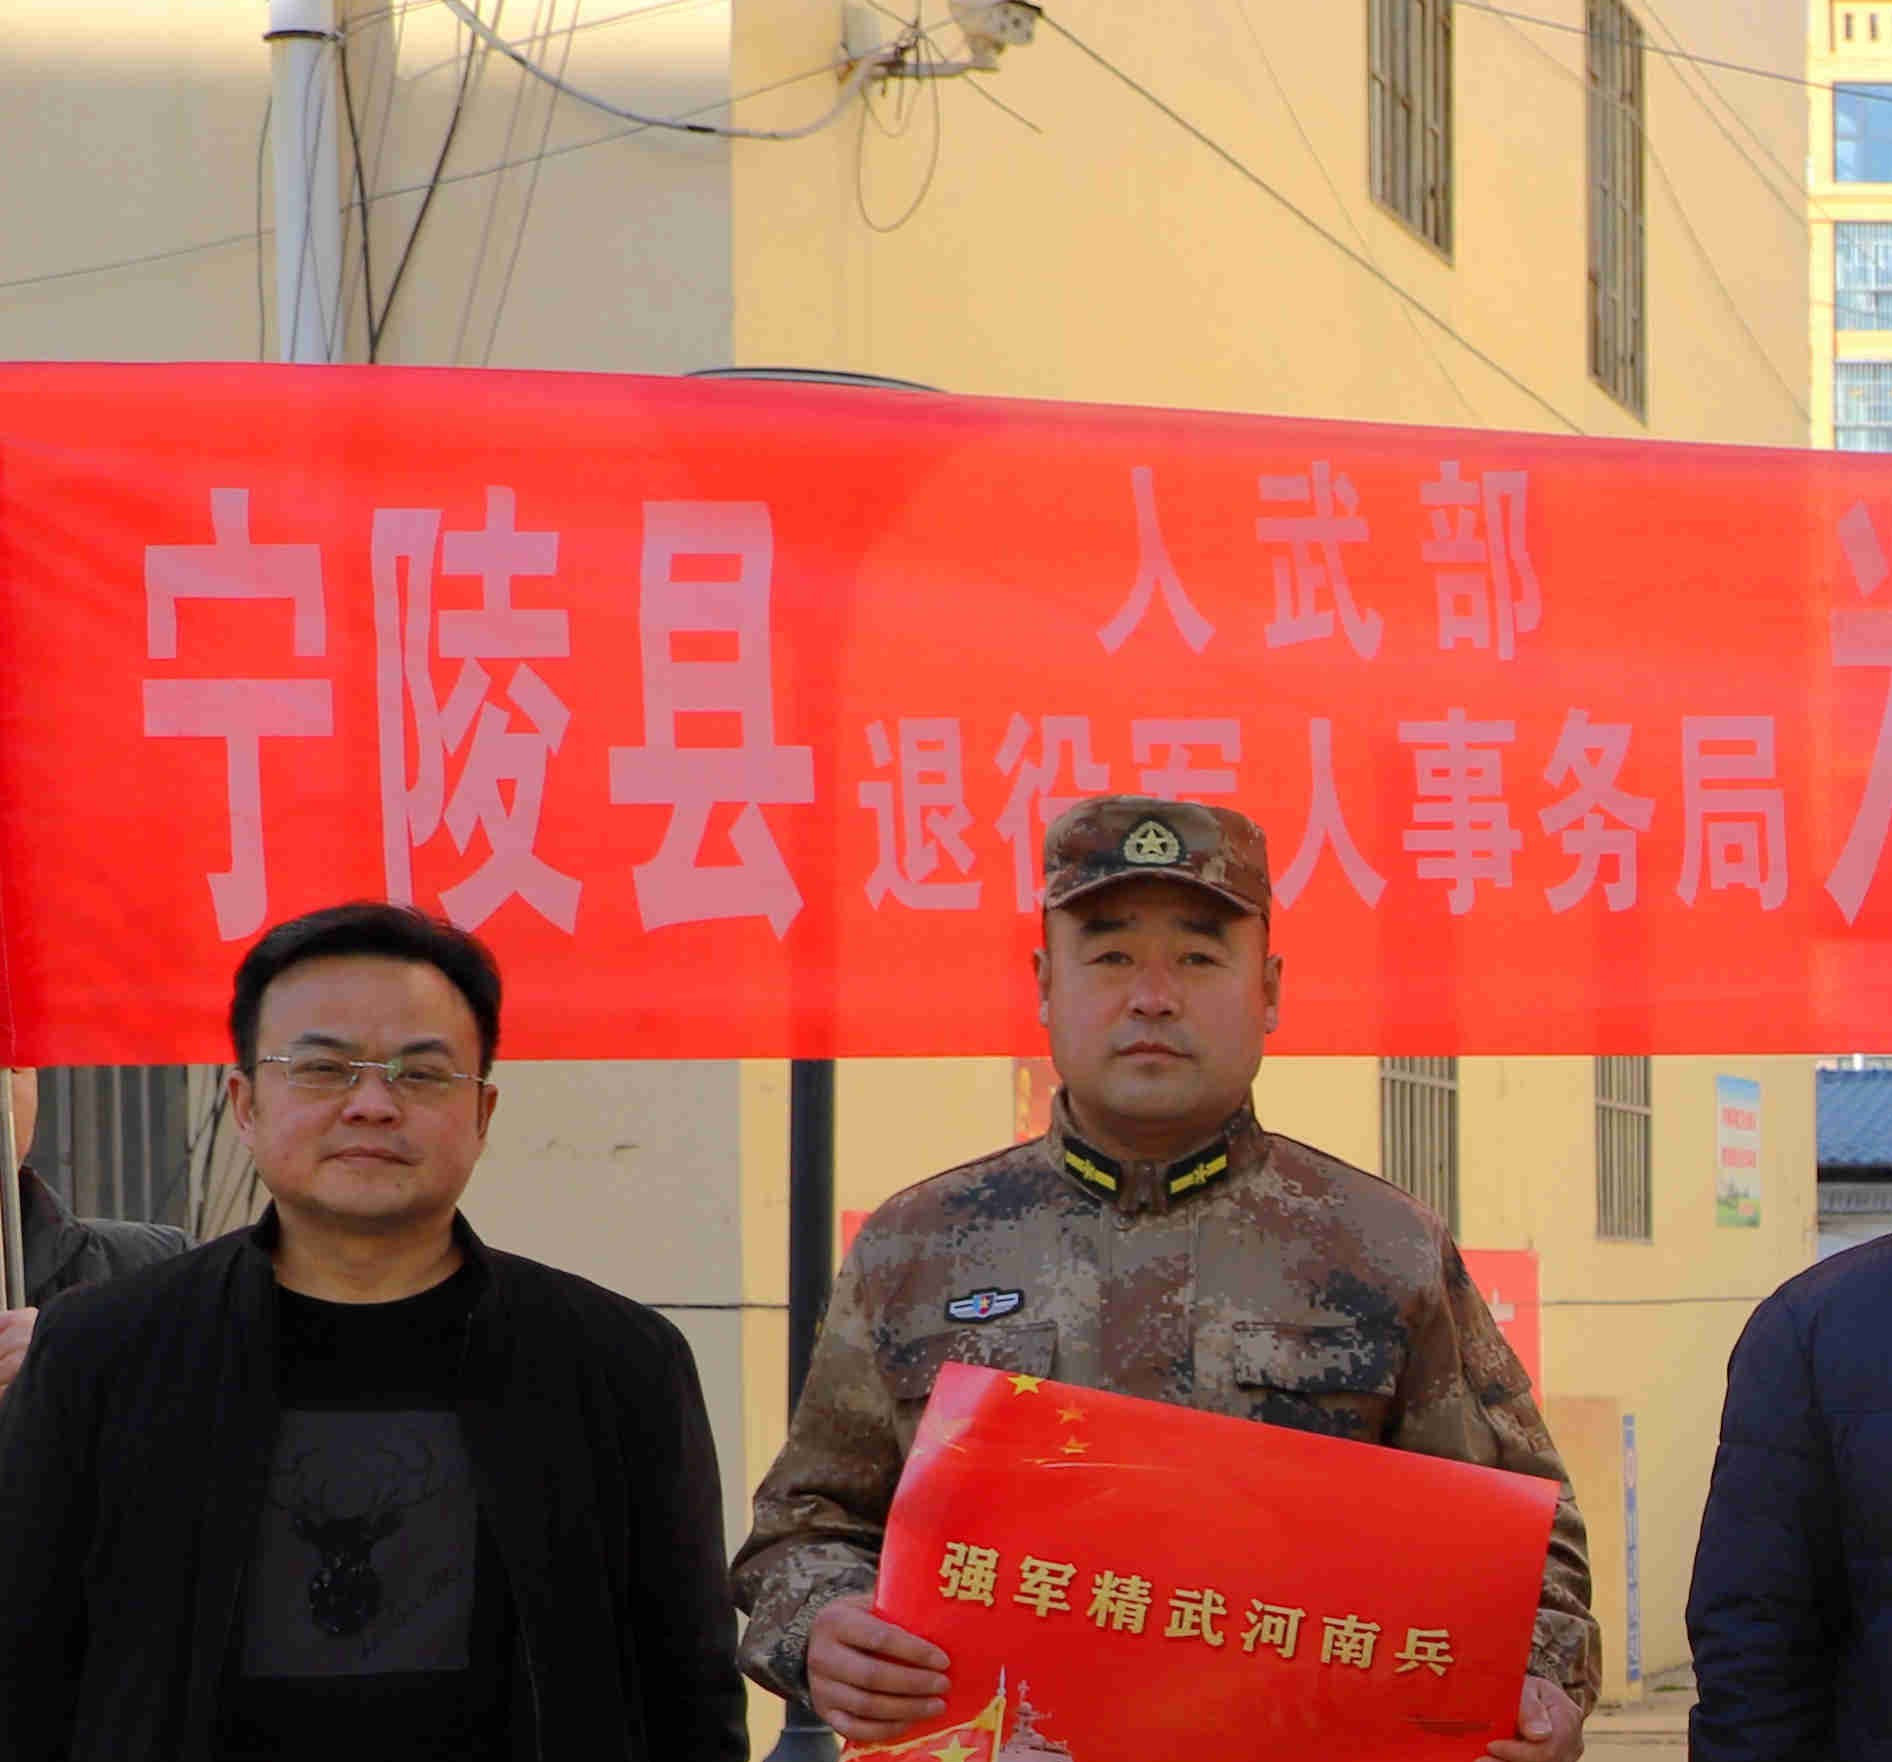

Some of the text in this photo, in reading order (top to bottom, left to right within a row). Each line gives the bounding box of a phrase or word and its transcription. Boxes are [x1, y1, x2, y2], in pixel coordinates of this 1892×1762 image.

[1096, 459, 1542, 661] 人武部
[142, 484, 816, 942] 宁陵县
[938, 1540, 1454, 1679] 强军精武河南兵
